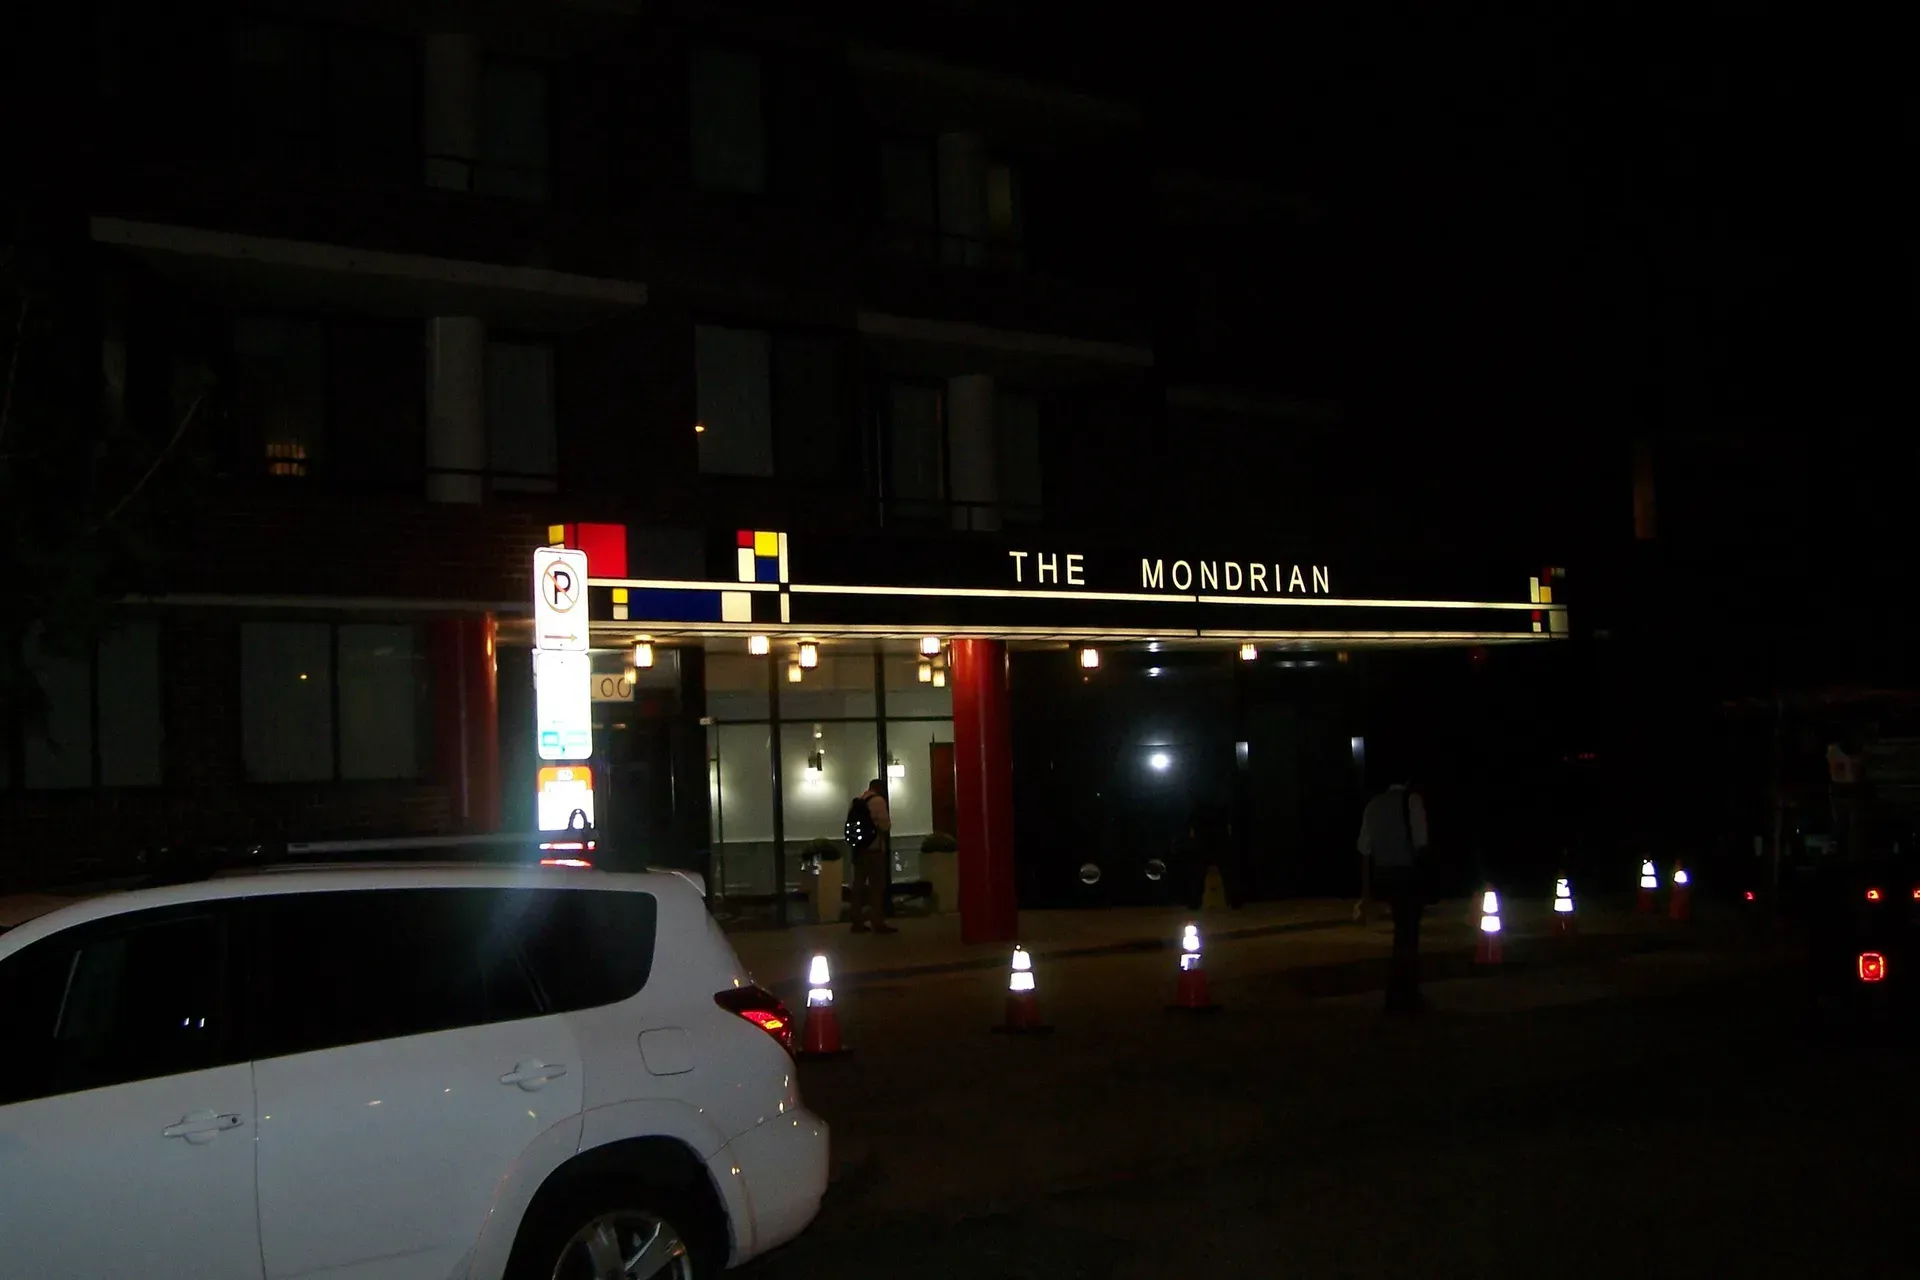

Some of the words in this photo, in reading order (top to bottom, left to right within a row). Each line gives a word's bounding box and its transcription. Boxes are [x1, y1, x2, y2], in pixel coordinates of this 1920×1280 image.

[554, 571, 571, 604] P
[1009, 551, 1085, 585] THE
[1142, 558, 1330, 593] MONDRIAN
